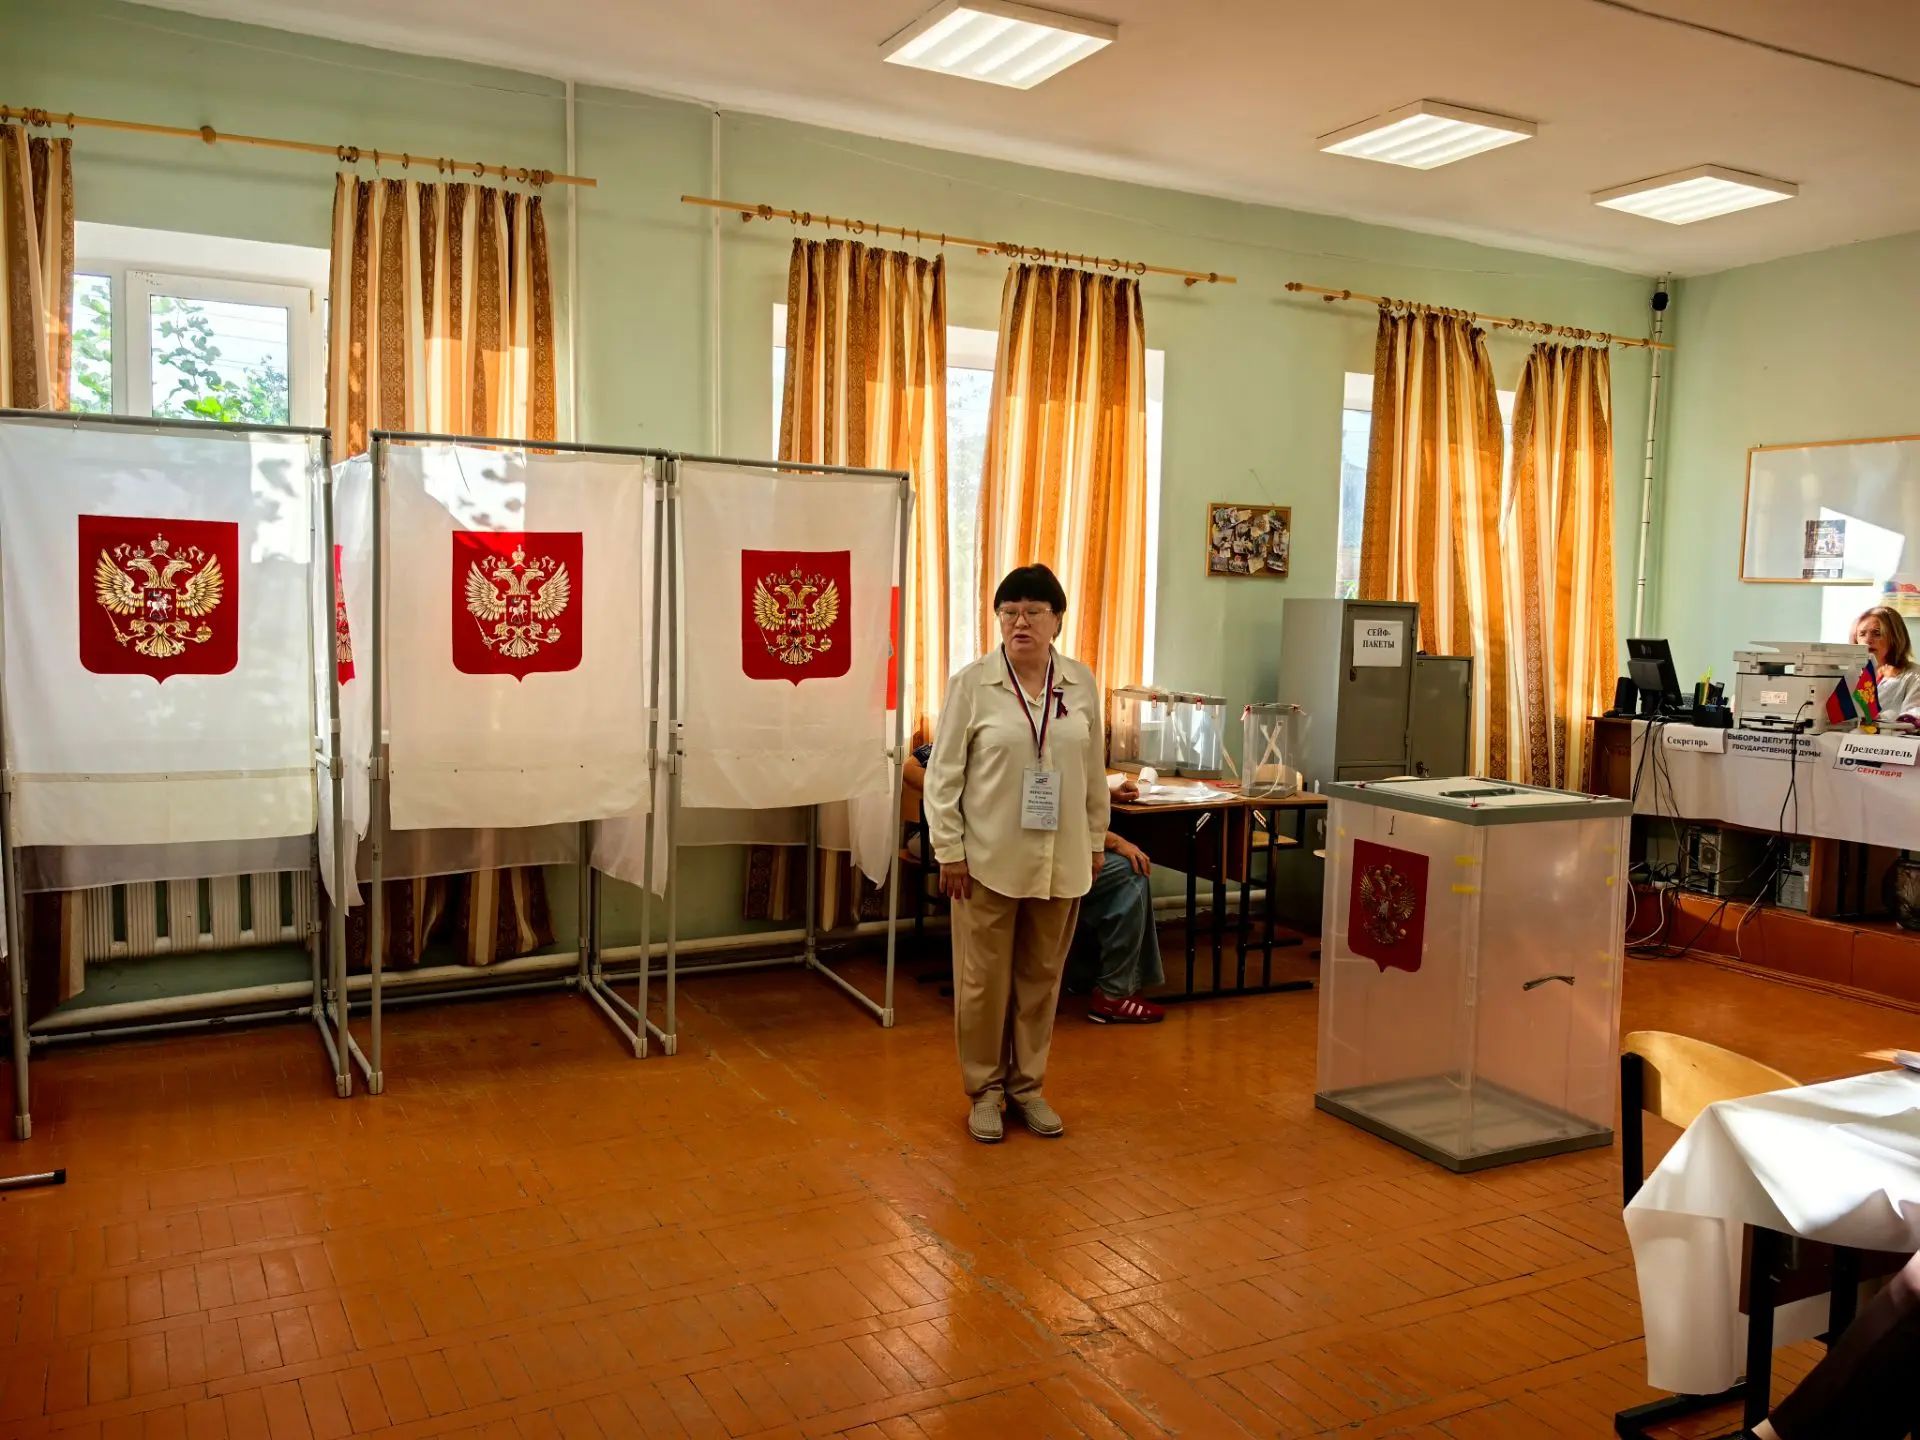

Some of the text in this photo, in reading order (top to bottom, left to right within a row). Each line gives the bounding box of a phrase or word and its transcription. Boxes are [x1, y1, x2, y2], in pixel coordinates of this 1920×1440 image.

[1367, 628, 1392, 637] СЕЙФ-
[1362, 640, 1395, 649] ПАКЕТЫ
[1667, 736, 1709, 747] Секретарь
[1727, 733, 1761, 743] ВЫБОРЫ
[1798, 749, 1822, 758] ДУМЫ
[1844, 743, 1913, 759] Председатель
[1857, 767, 1903, 778] СЕНТЯБРЯ
